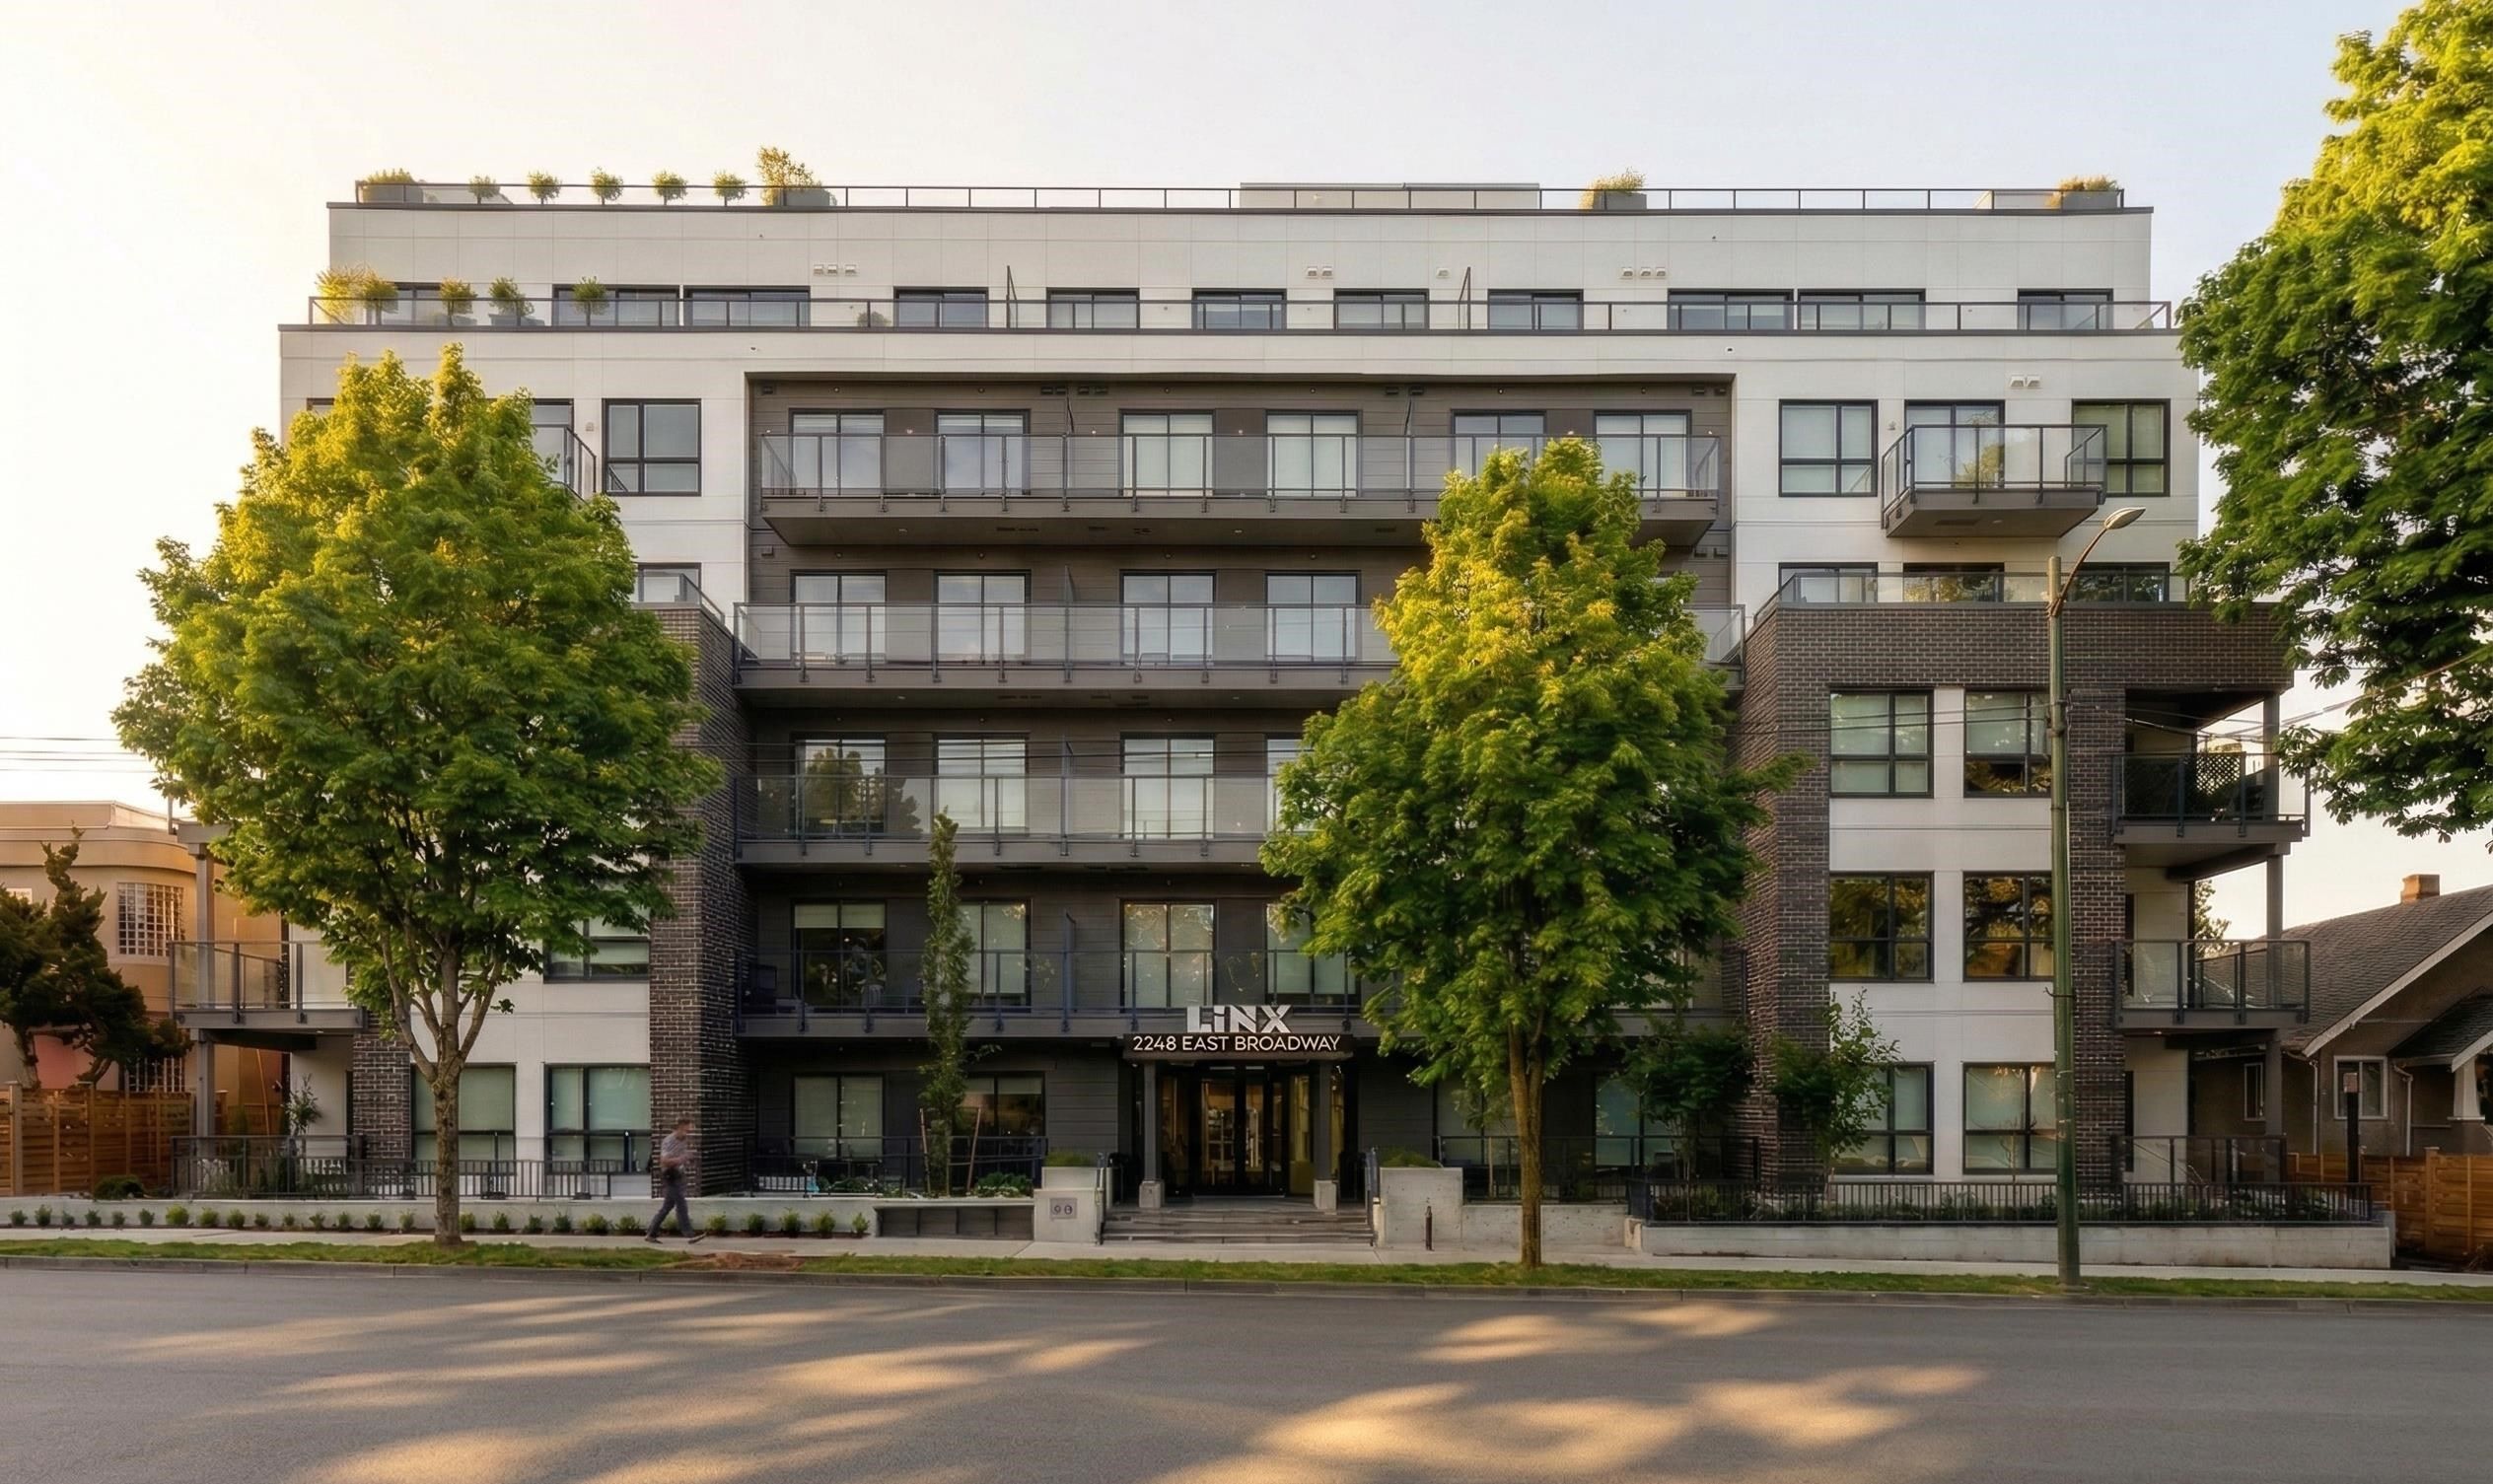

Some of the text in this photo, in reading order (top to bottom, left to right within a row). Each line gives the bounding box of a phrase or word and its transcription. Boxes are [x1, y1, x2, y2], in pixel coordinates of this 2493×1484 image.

[1133, 1035, 1340, 1051] 2248 EAST BROADWAY
